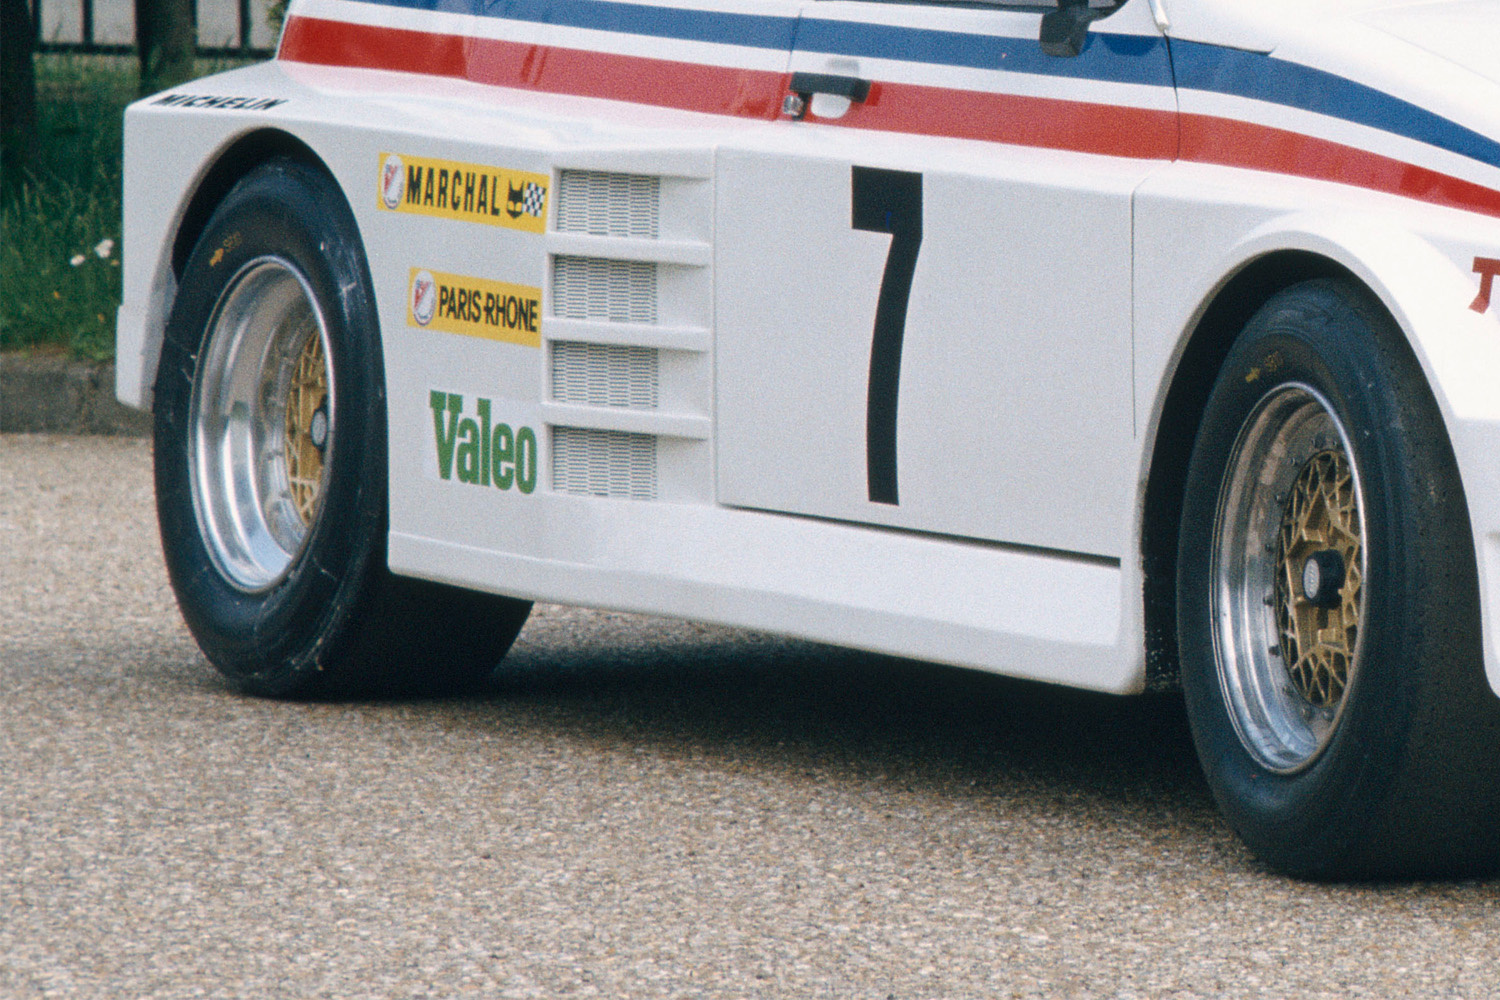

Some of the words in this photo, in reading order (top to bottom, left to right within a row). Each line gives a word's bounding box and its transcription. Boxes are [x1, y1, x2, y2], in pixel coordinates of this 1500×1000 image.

[150, 94, 289, 110] MICHELIN
[406, 165, 501, 216] MARCHAL
[852, 165, 923, 506] 7
[429, 389, 537, 494] Valeo
